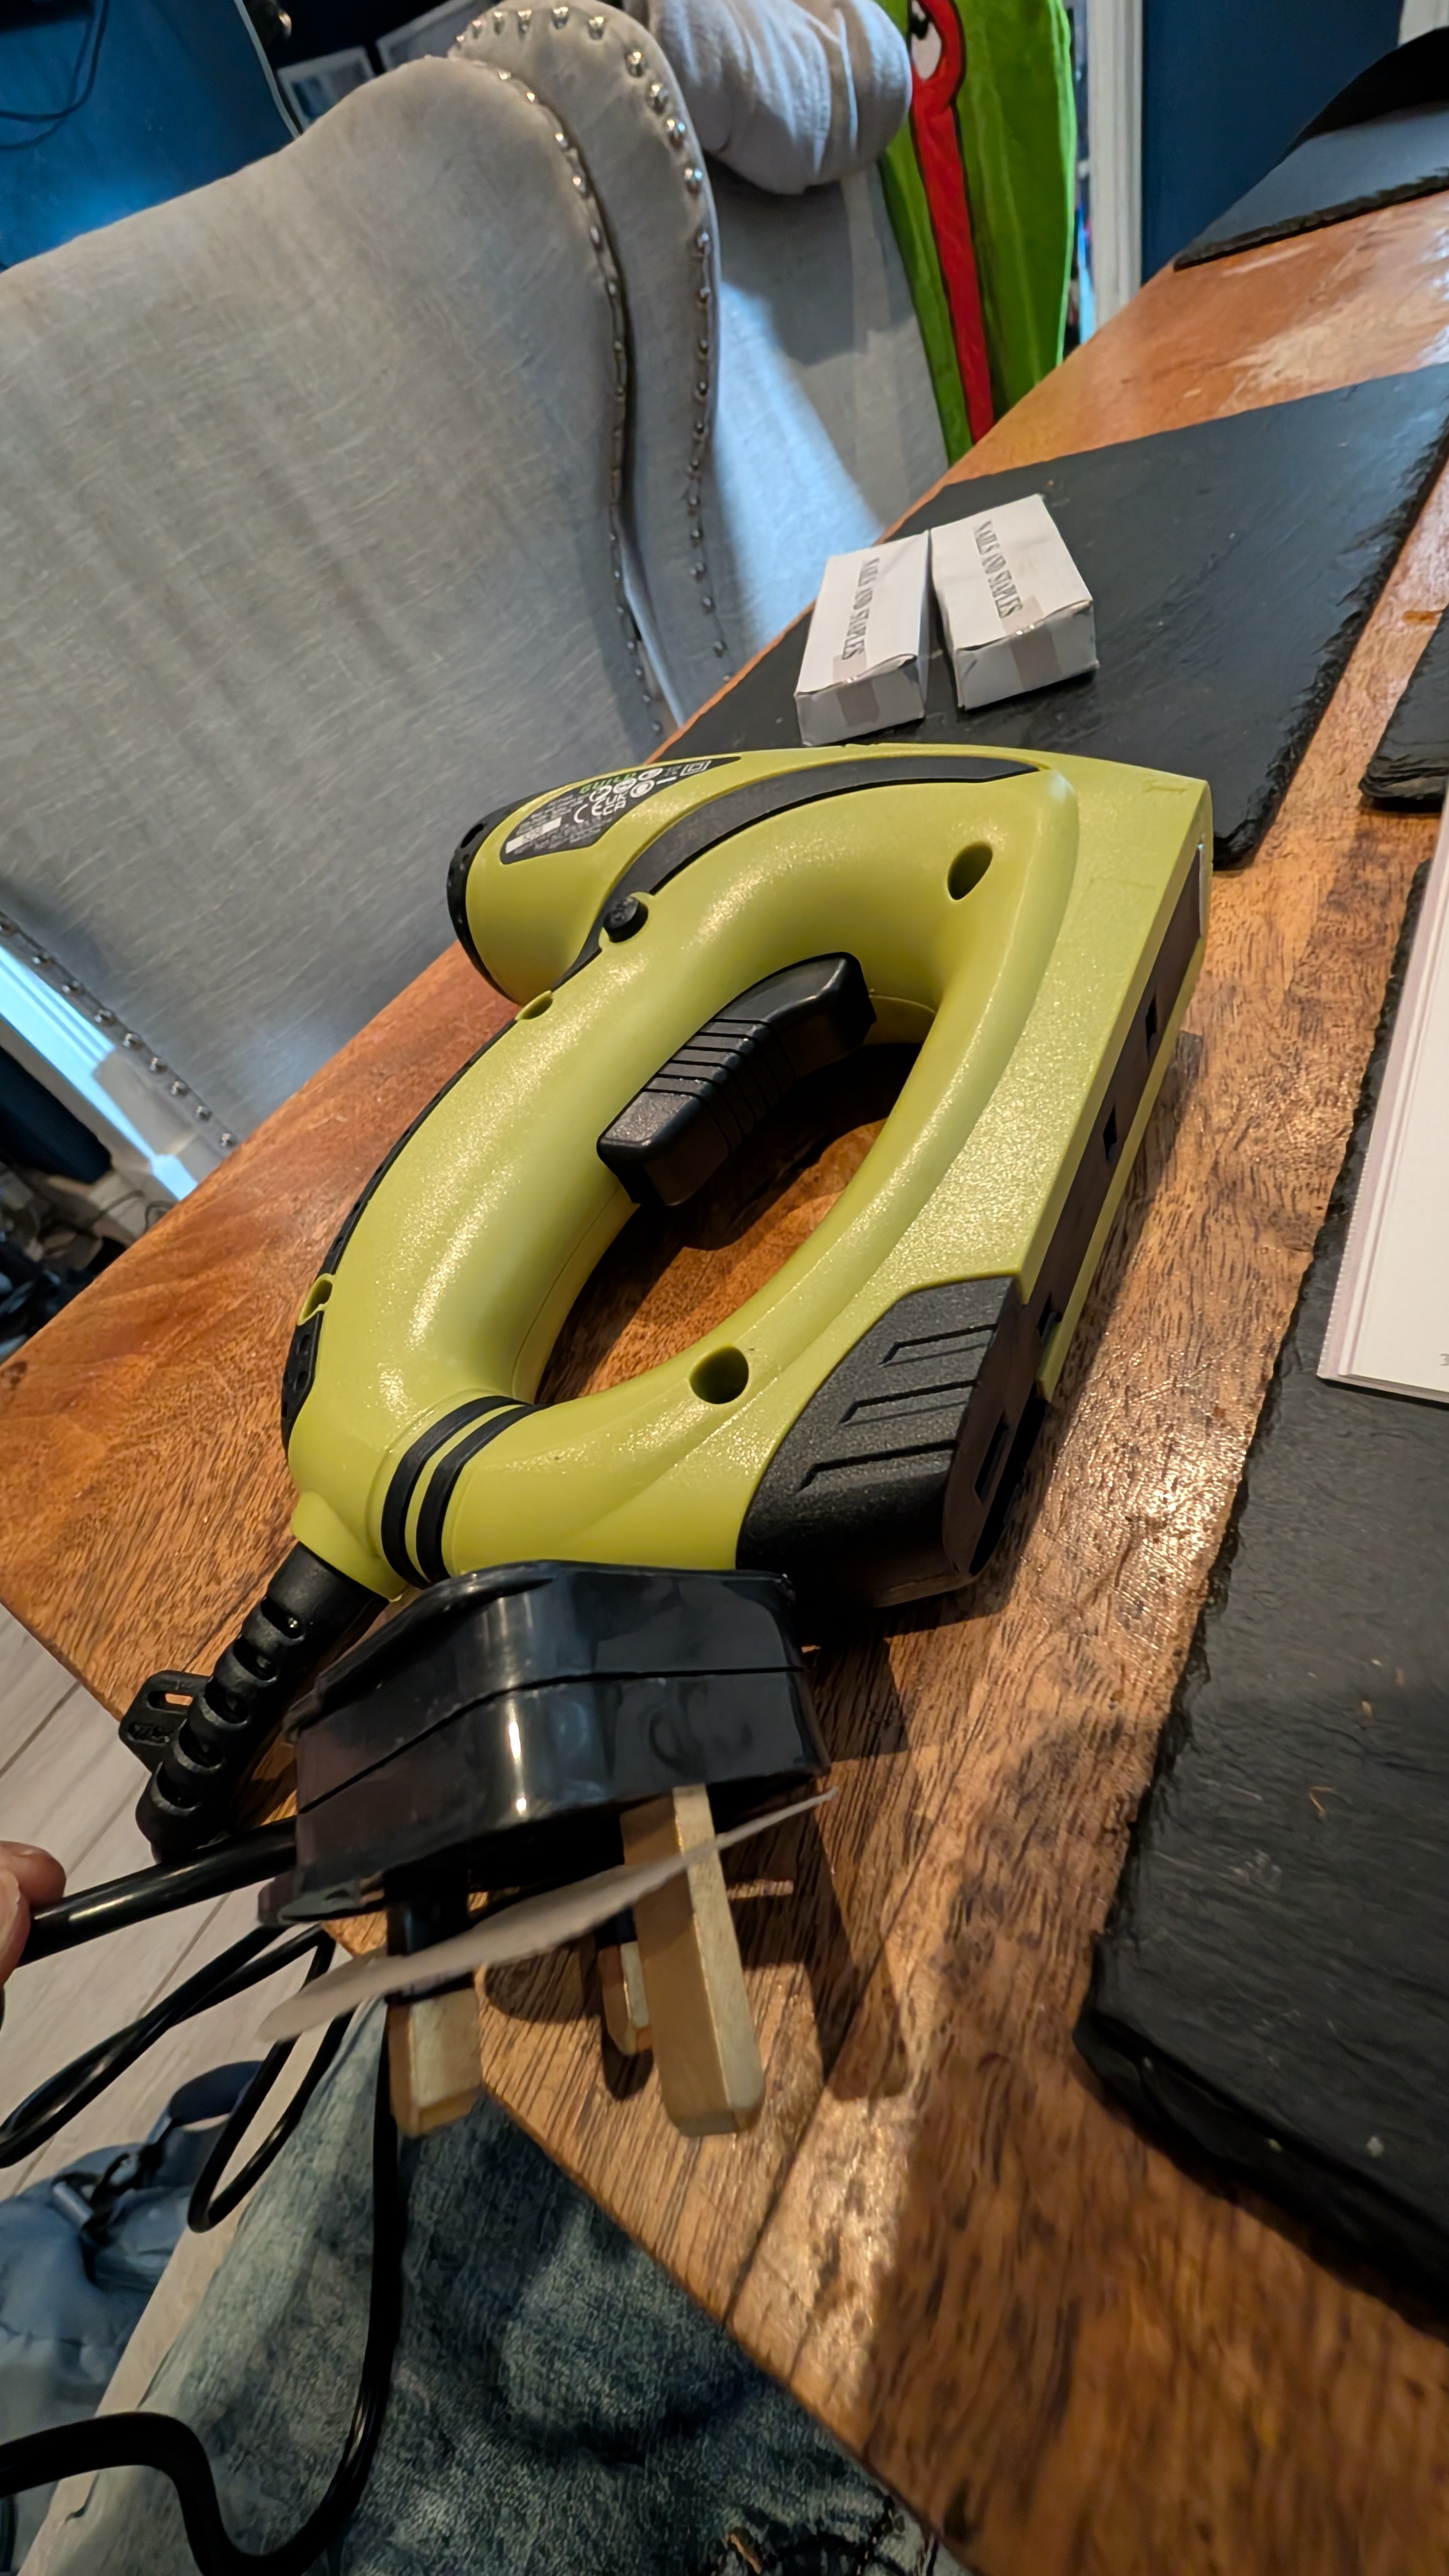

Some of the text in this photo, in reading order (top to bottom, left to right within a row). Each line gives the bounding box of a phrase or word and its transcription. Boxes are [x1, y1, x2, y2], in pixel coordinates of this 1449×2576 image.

[974, 520, 1022, 618] NAILS AND STAPLES
[606, 791, 629, 806] UK
[602, 800, 627, 816] CA
